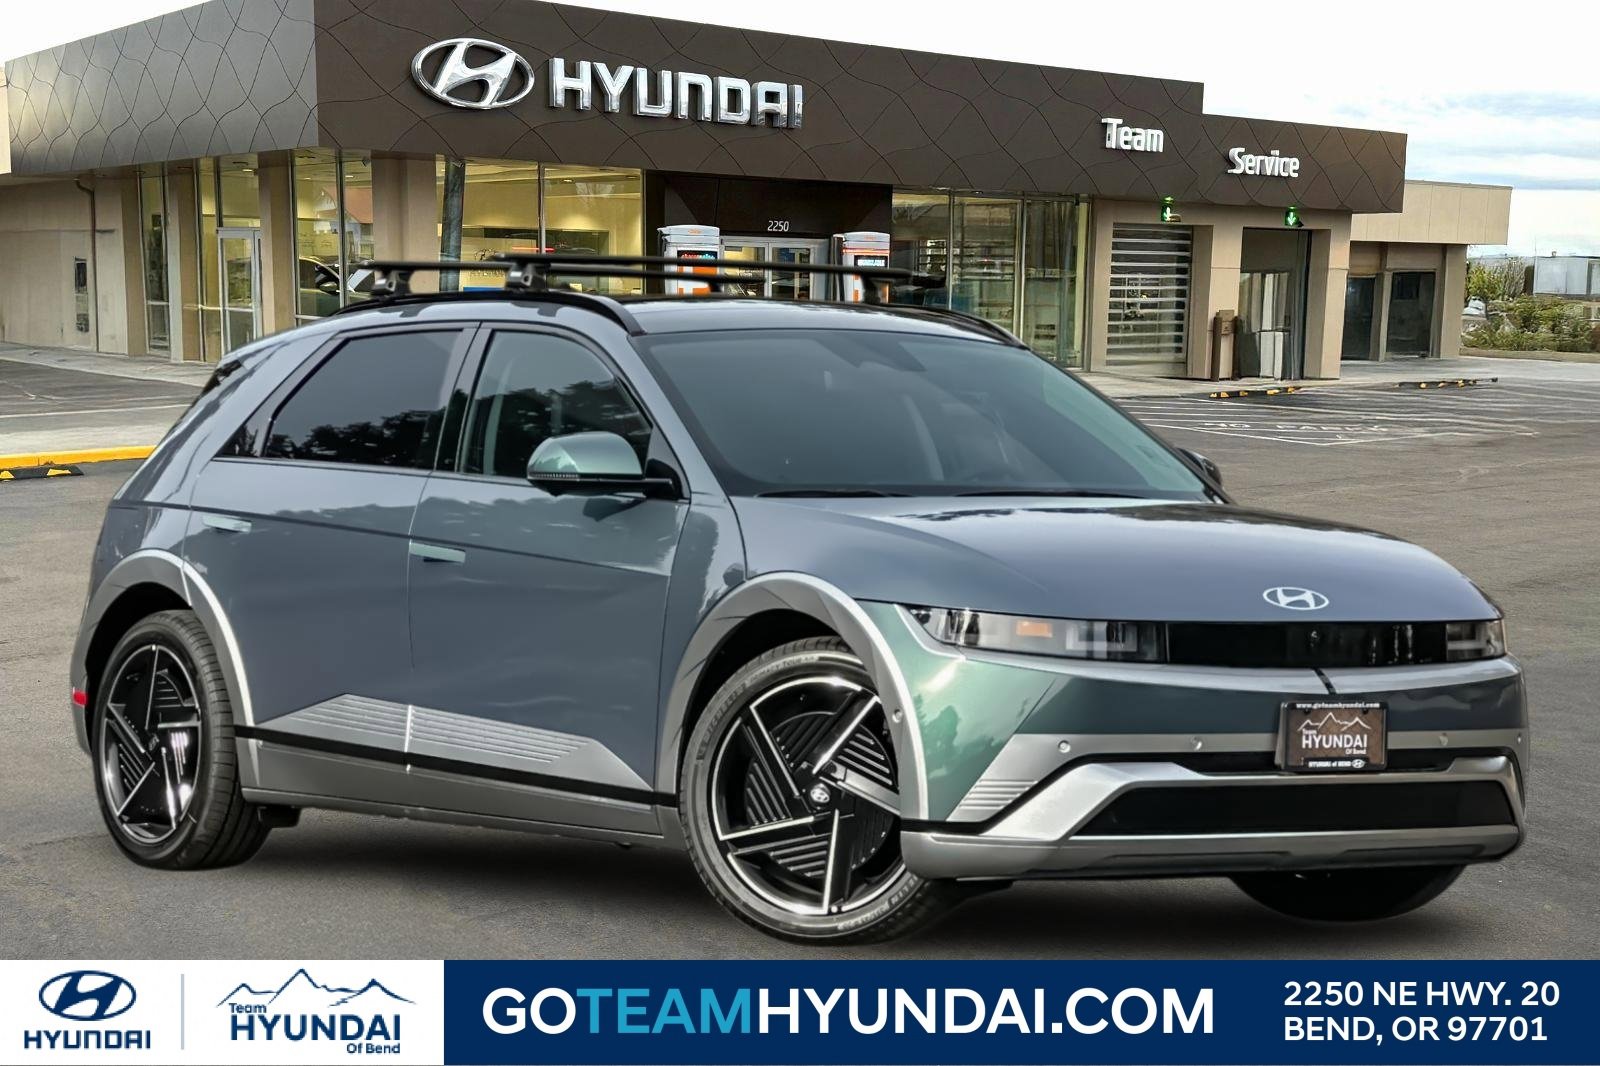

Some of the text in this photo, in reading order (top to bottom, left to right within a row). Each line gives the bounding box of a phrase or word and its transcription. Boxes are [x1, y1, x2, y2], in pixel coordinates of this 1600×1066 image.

[549, 57, 803, 128] HYUNDAI
[1102, 118, 1164, 152] Team
[1228, 147, 1300, 178] Service
[767, 221, 789, 232] 2250
[1302, 734, 1367, 749] HYUNDAI
